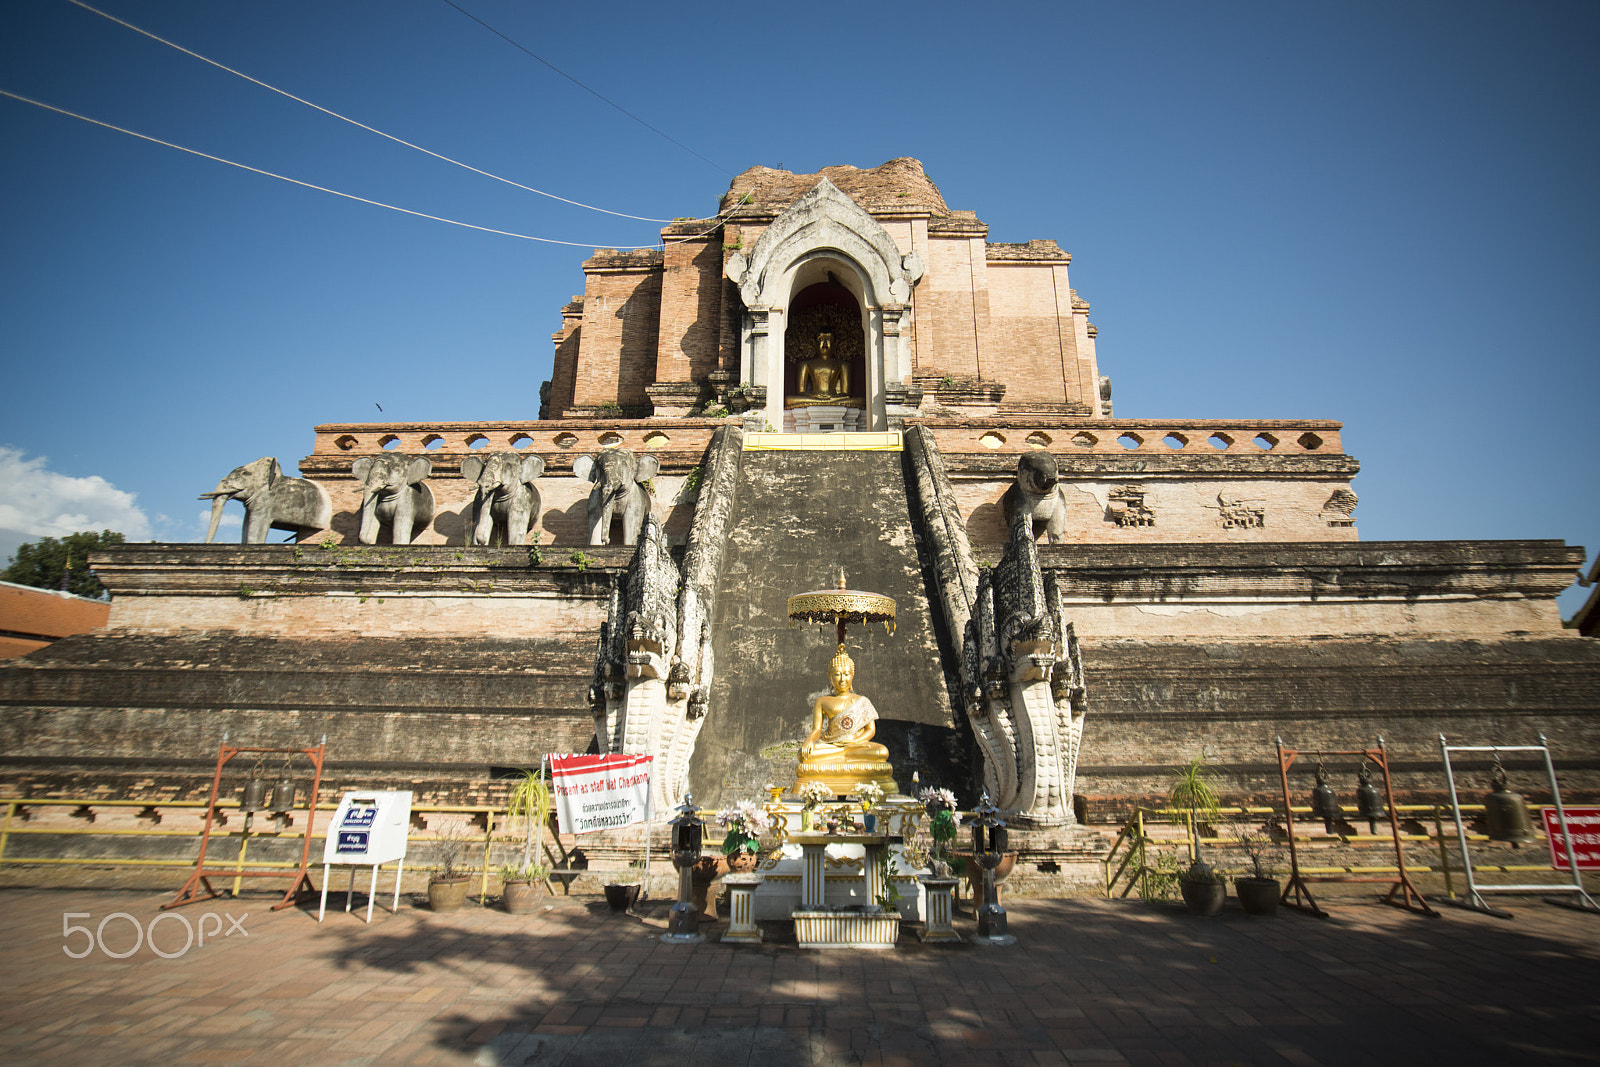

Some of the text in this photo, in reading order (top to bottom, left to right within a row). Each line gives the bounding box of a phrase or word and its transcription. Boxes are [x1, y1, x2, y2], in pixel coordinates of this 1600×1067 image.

[556, 784, 579, 796] Present
[580, 783, 589, 794] as
[590, 779, 605, 792] staff
[606, 778, 617, 790] Wat
